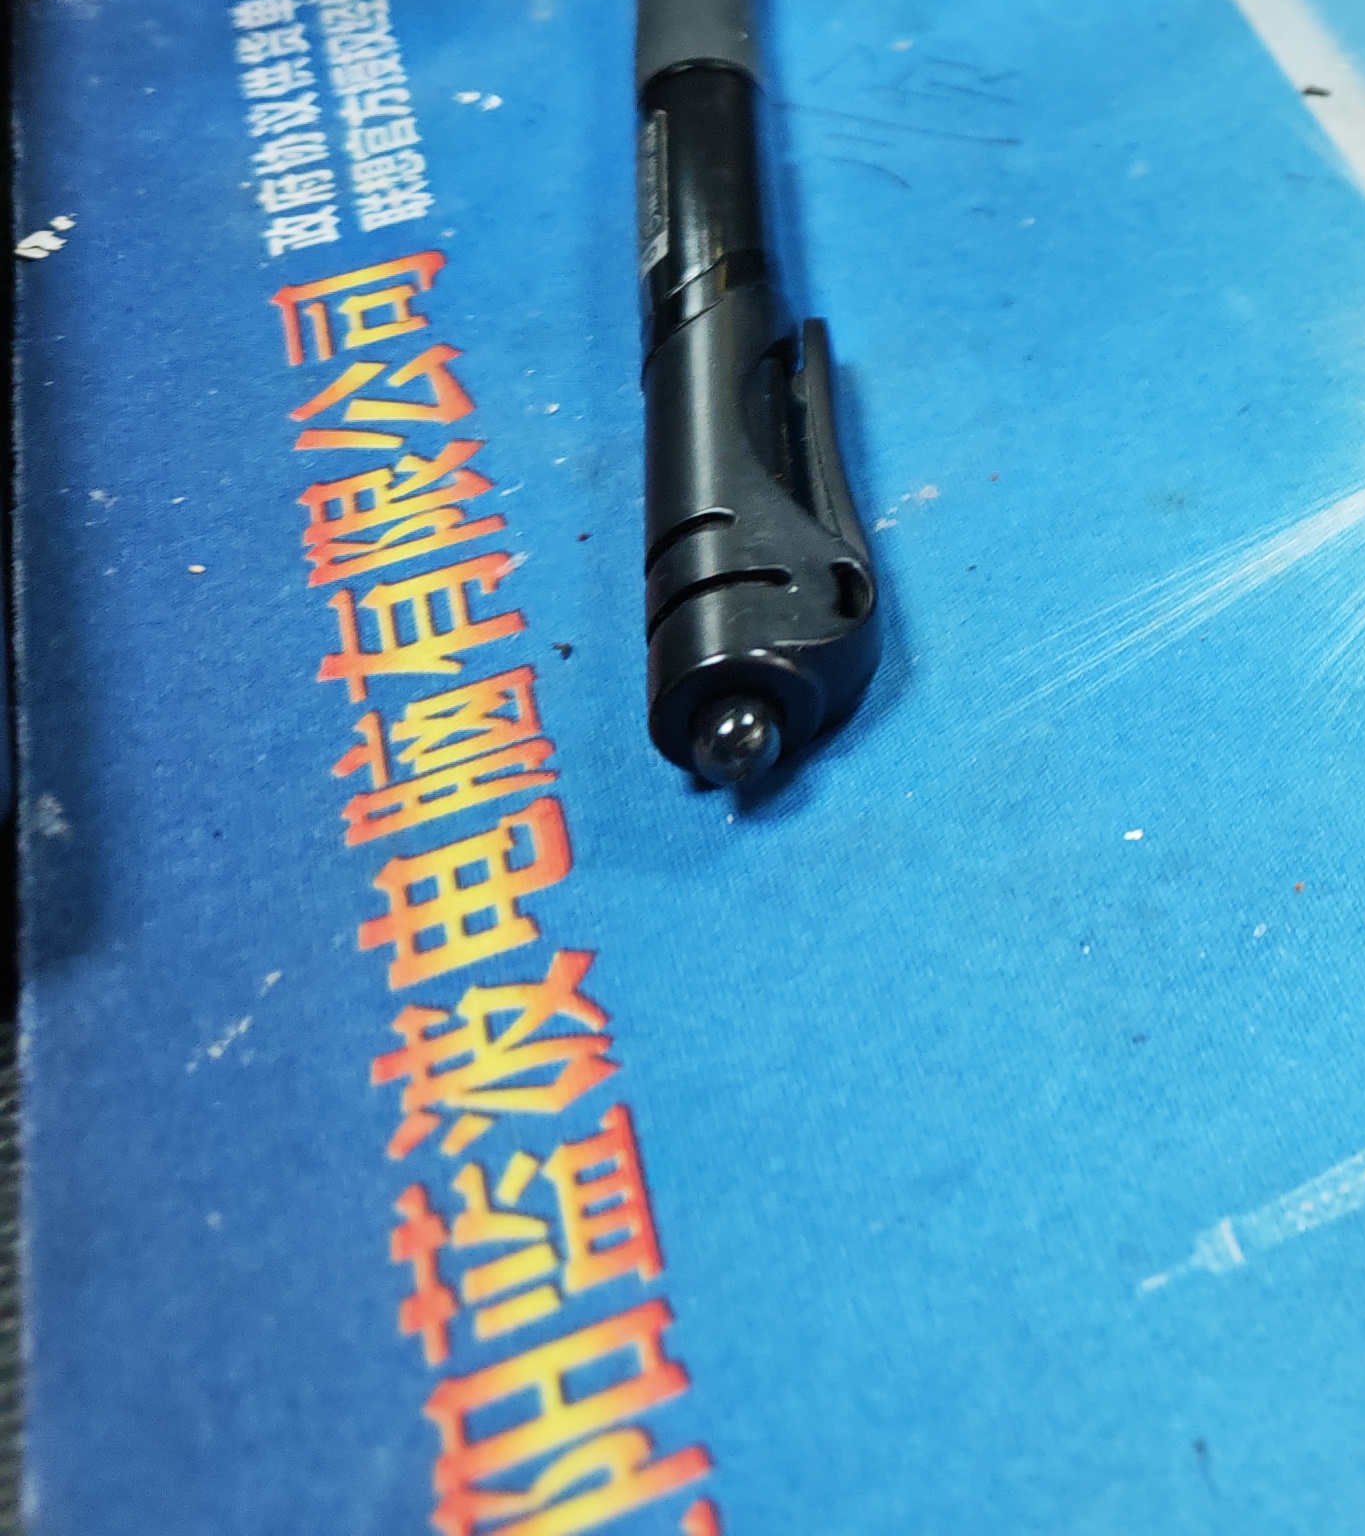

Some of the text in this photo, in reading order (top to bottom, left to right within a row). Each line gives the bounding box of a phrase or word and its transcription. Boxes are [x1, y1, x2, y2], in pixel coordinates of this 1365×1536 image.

[268, 249, 722, 1536] 阳蓝波电脑有限公司
